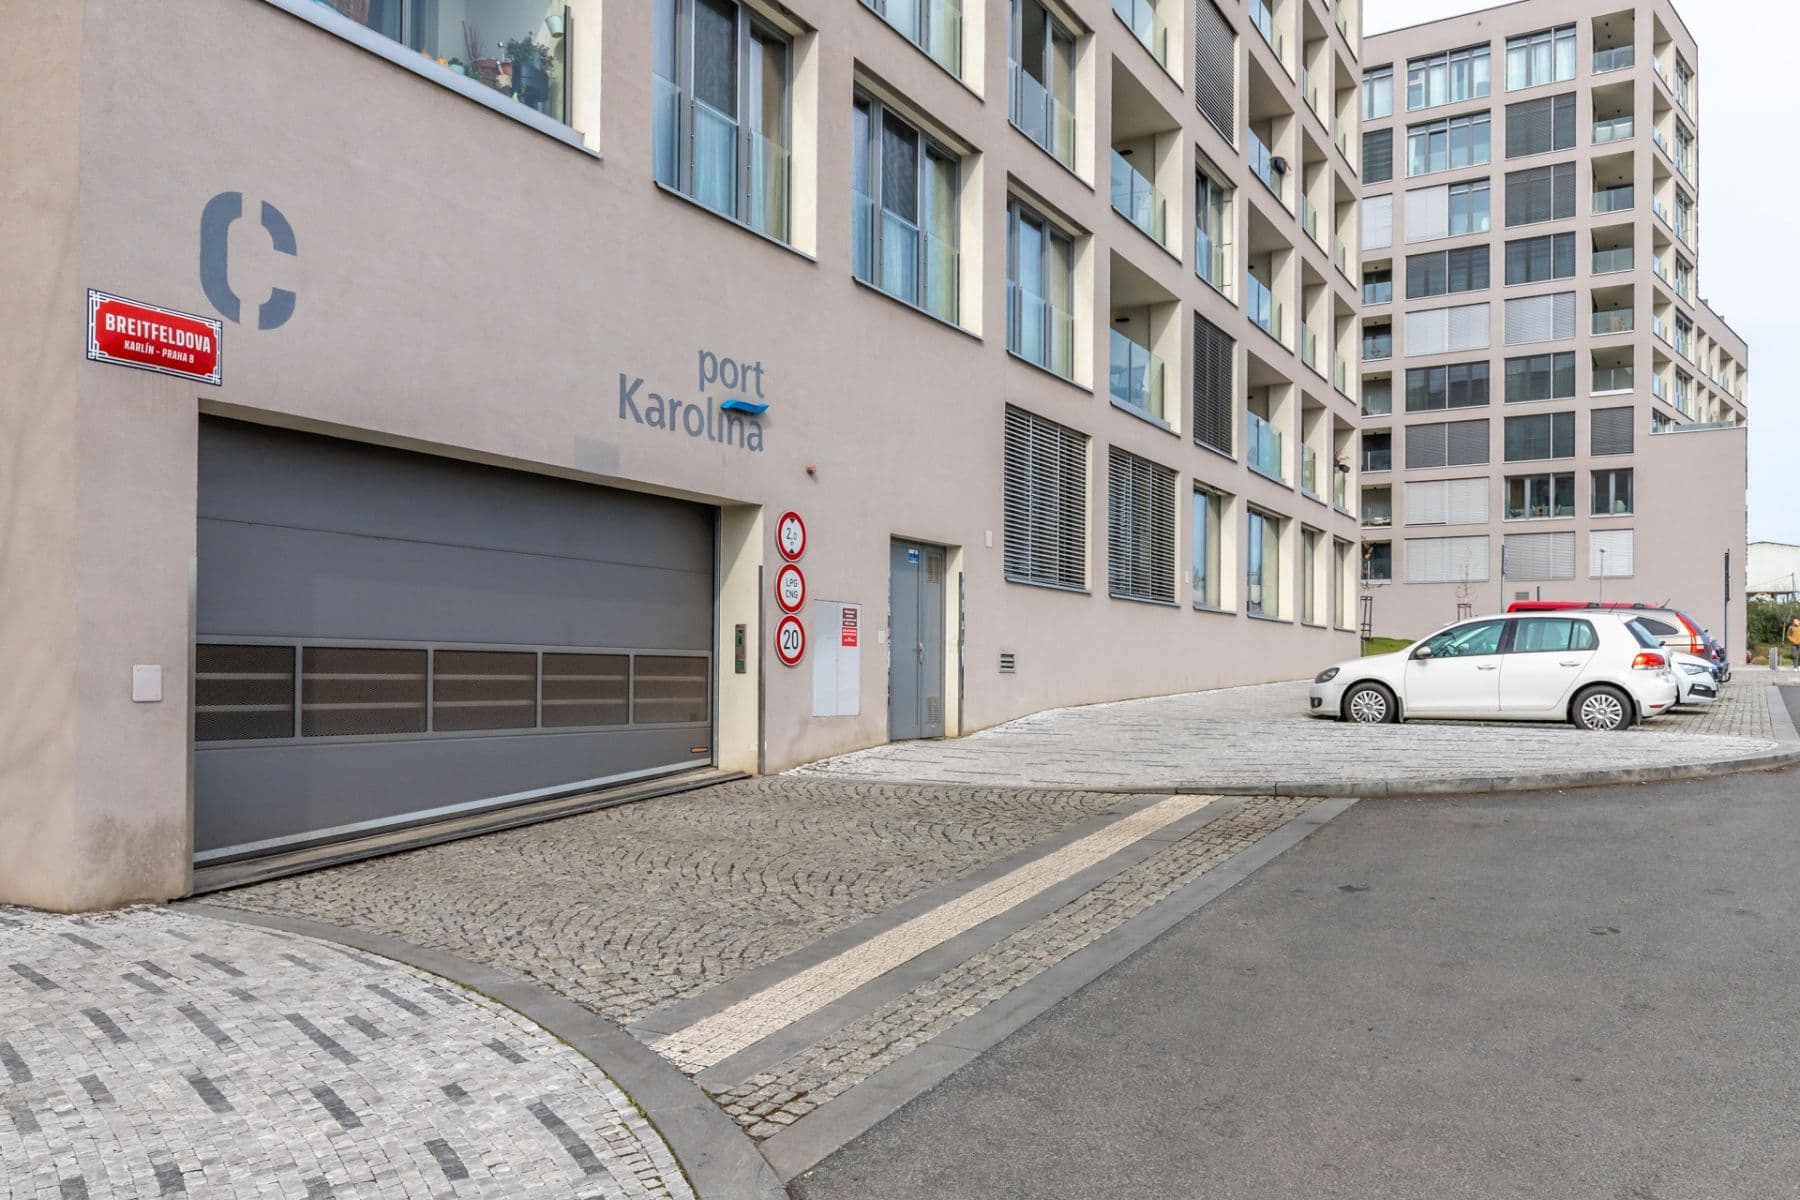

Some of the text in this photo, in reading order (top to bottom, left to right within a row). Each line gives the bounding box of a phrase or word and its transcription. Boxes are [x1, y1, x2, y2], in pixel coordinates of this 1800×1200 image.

[105, 313, 211, 353] BREITFELDOVA
[124, 340, 155, 355] KARLÍN
[162, 348, 188, 363] PRAHA
[188, 354, 195, 364] 8
[698, 349, 765, 399] port
[619, 373, 764, 452] Karolina
[785, 578, 798, 588] LPG
[785, 589, 799, 599] CNG
[783, 629, 799, 650] 20
